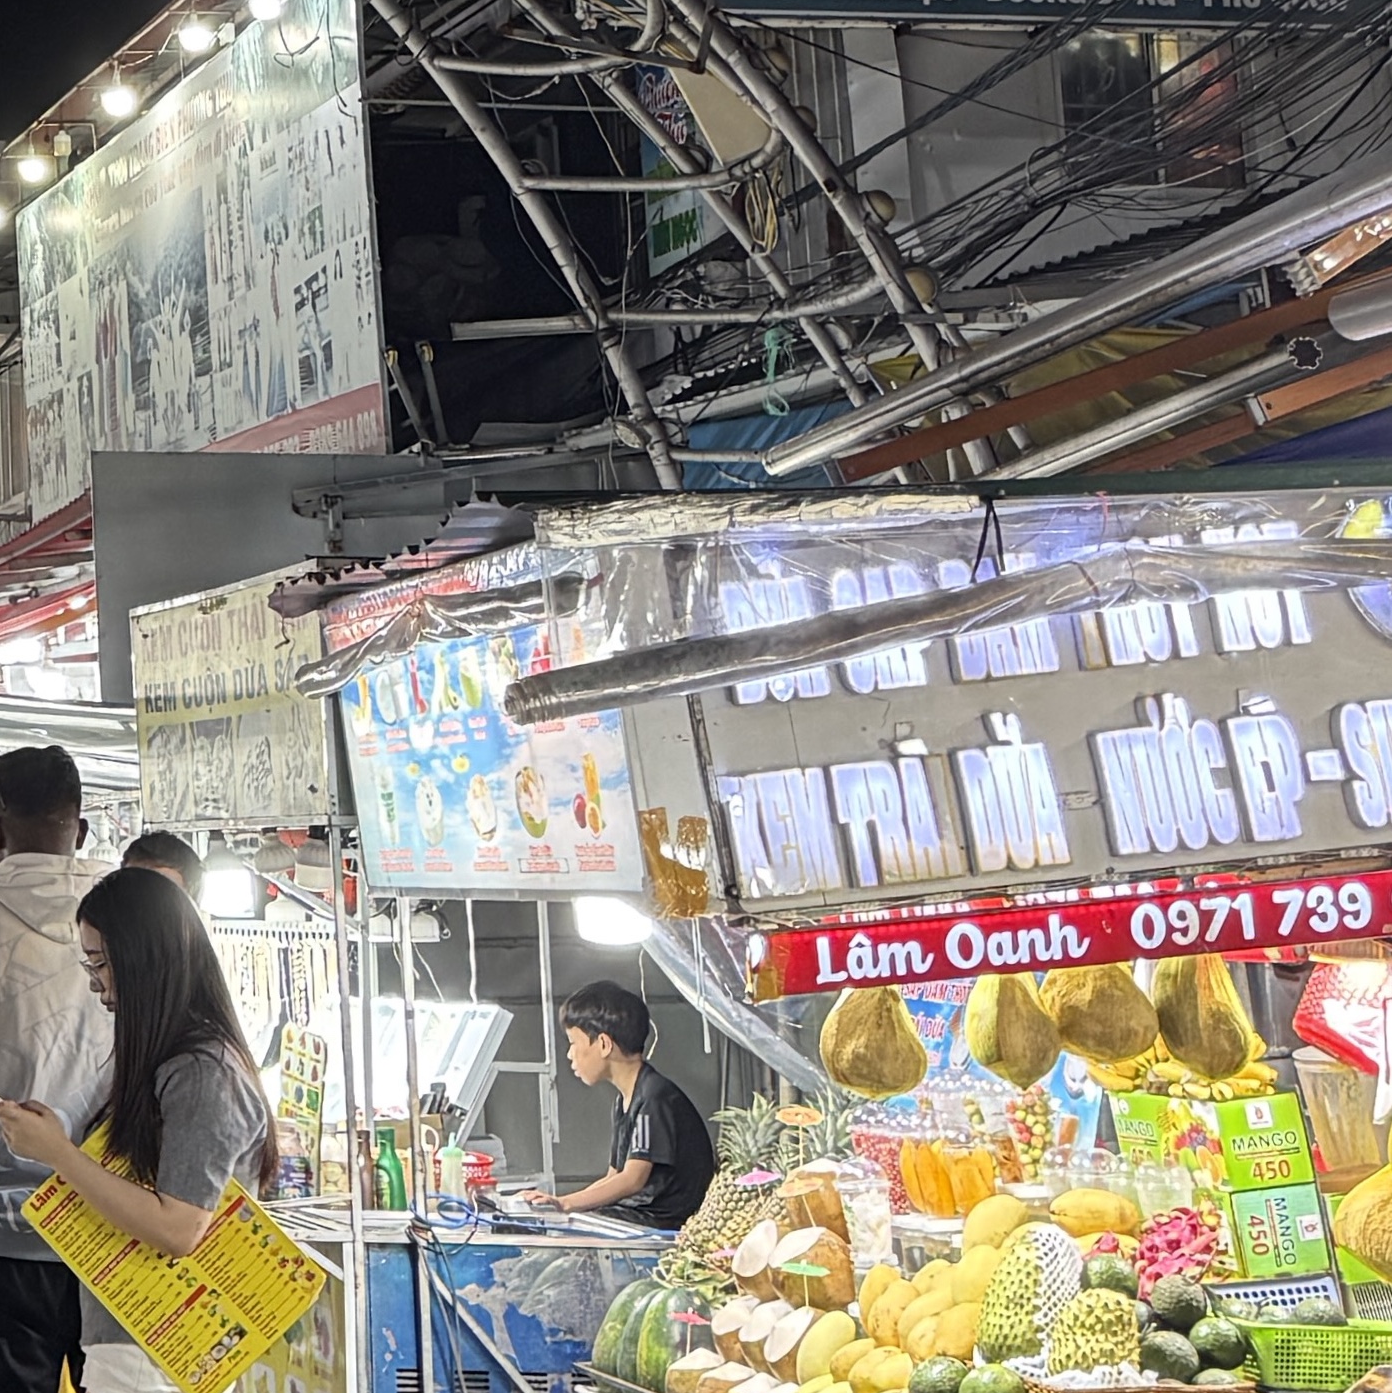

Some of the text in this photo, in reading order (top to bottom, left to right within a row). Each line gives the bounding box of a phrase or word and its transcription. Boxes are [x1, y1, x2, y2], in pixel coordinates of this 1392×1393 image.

[144, 679, 177, 714] KEM
[1093, 692, 1241, 856] NƯỚC
[815, 932, 935, 986] Lâm
[944, 913, 1091, 970] Oanh
[1129, 893, 1256, 950] 0971
[1271, 881, 1373, 937] 739
[1232, 1130, 1298, 1152] MANGO
[1252, 1158, 1291, 1182] 450
[1247, 1214, 1270, 1257] 450
[1273, 1197, 1297, 1266] MANGO
